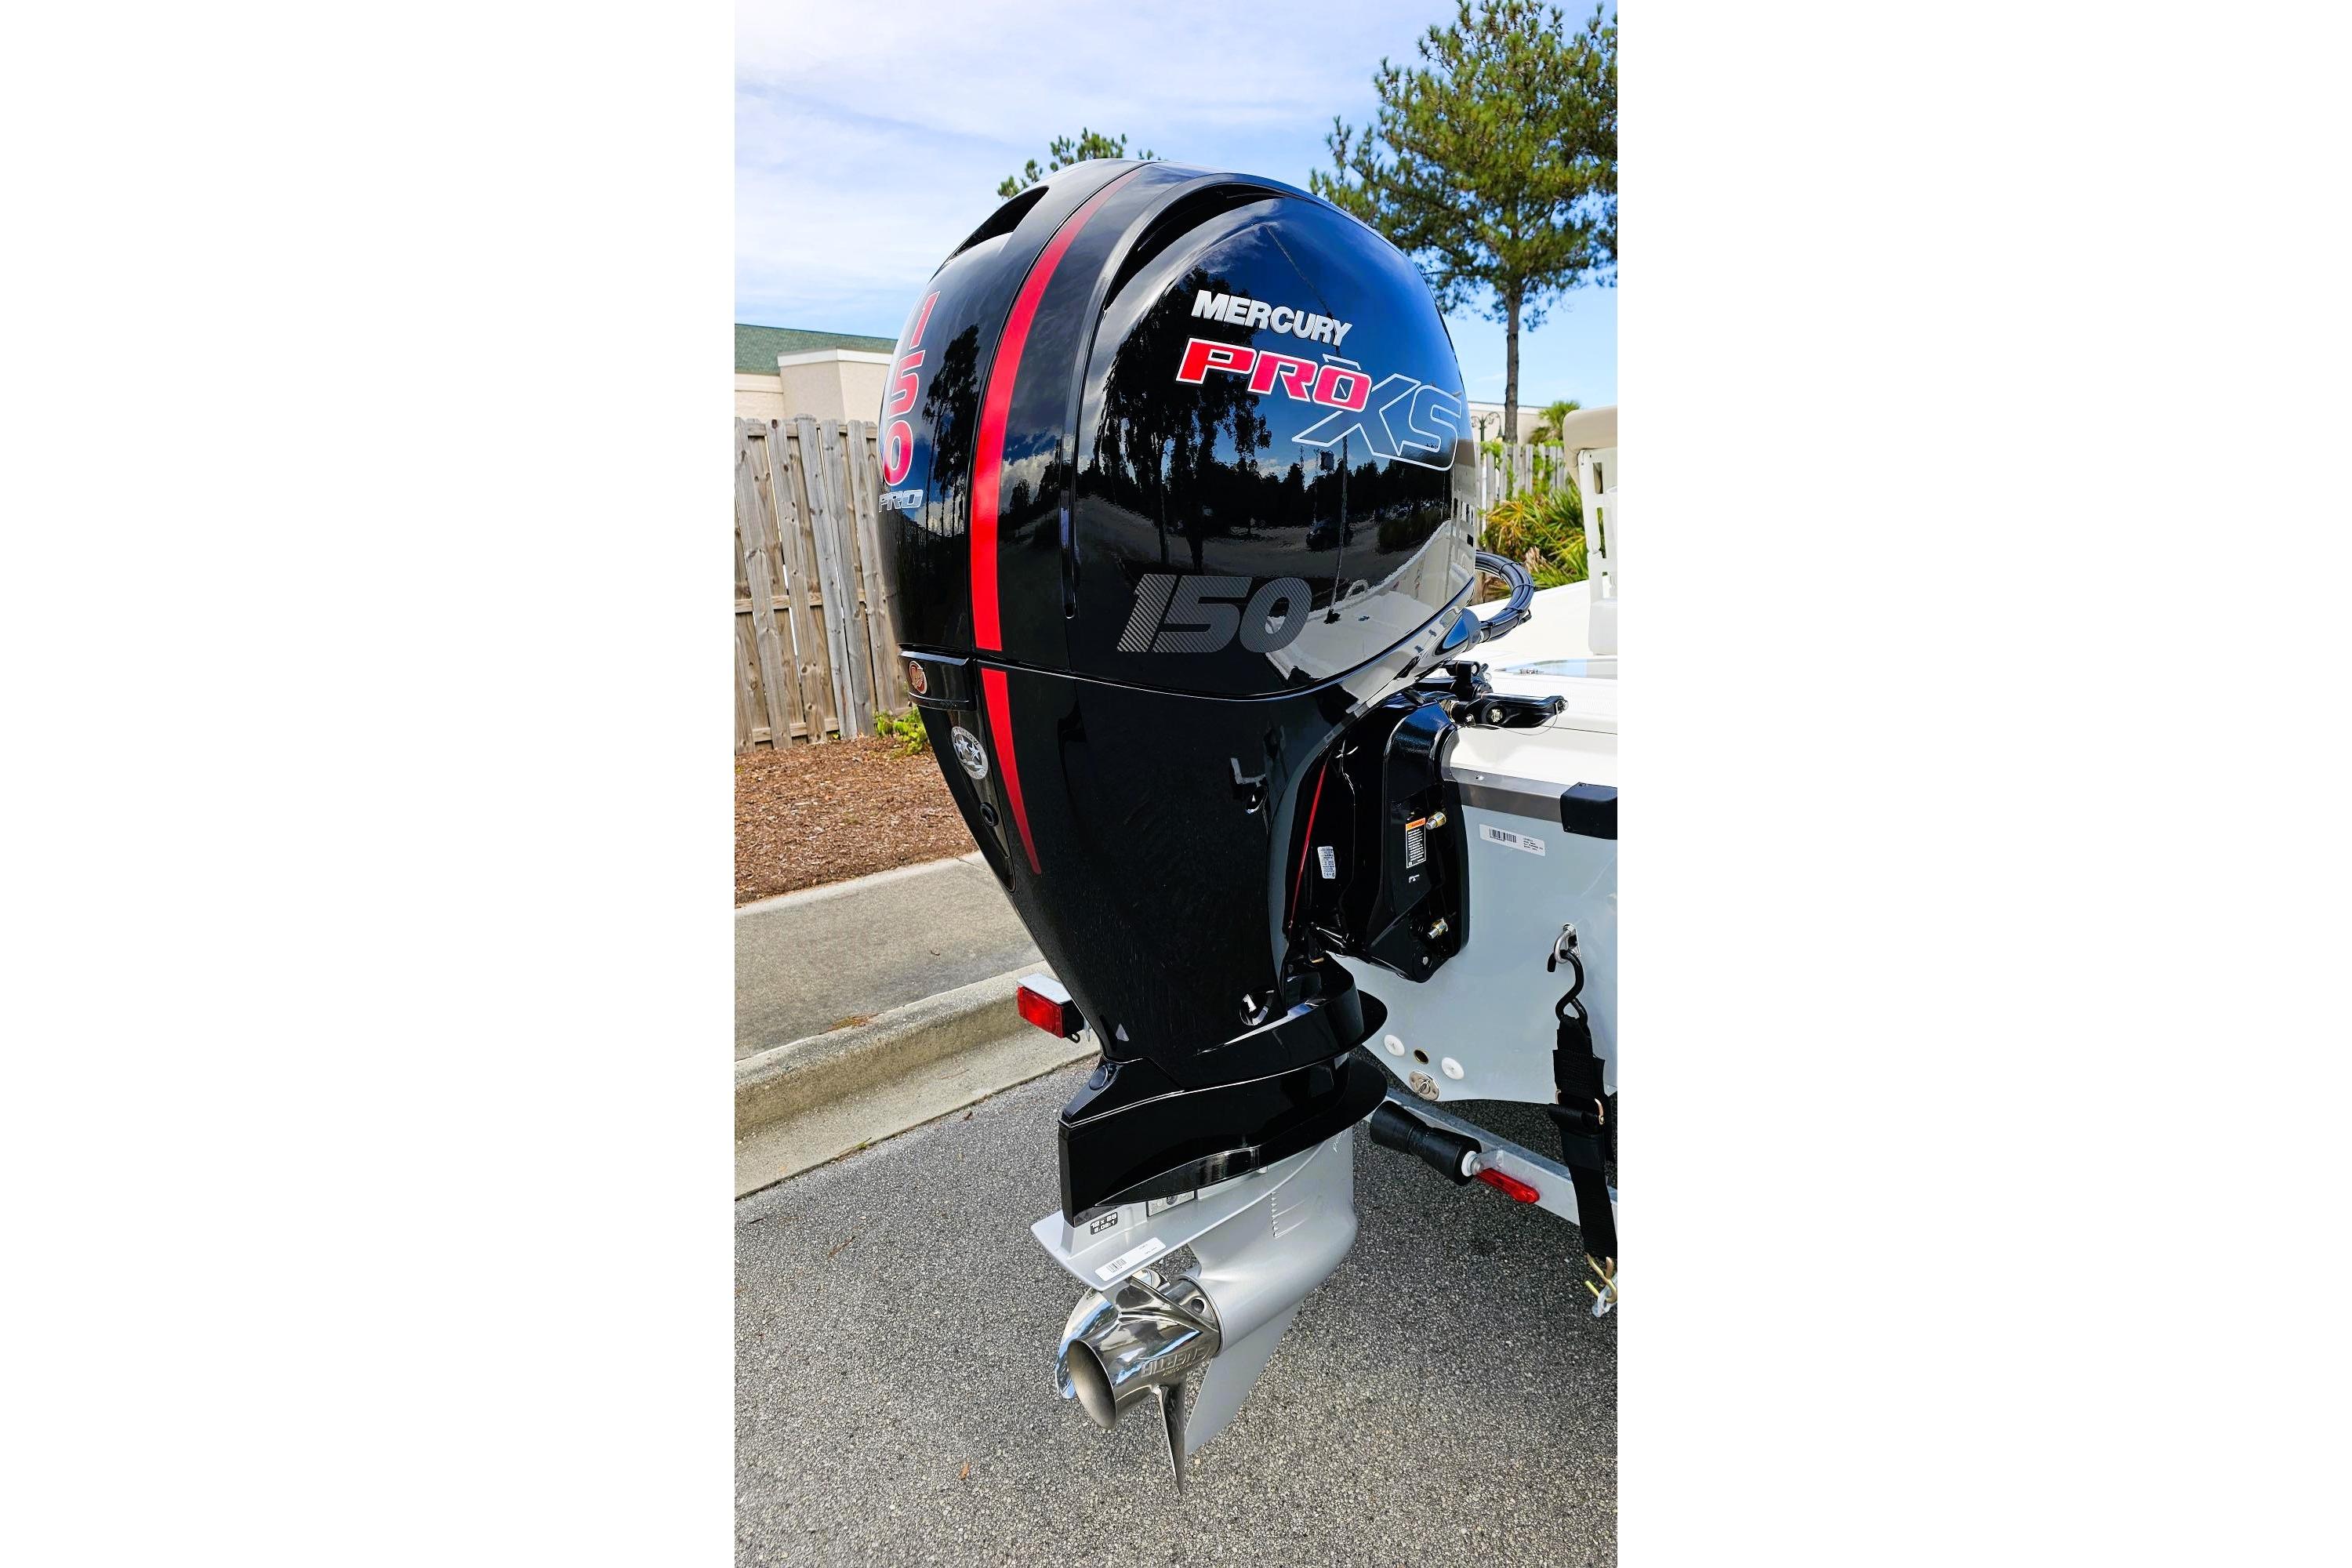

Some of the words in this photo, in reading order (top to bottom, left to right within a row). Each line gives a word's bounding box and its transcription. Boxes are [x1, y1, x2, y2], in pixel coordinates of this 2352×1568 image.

[1191, 289, 1352, 347] MERCURY
[883, 291, 940, 486] 150
[1176, 337, 1373, 412] PRO
[1291, 353, 1462, 471] XS
[879, 489, 924, 513] PRO
[1116, 573, 1312, 653] 150
